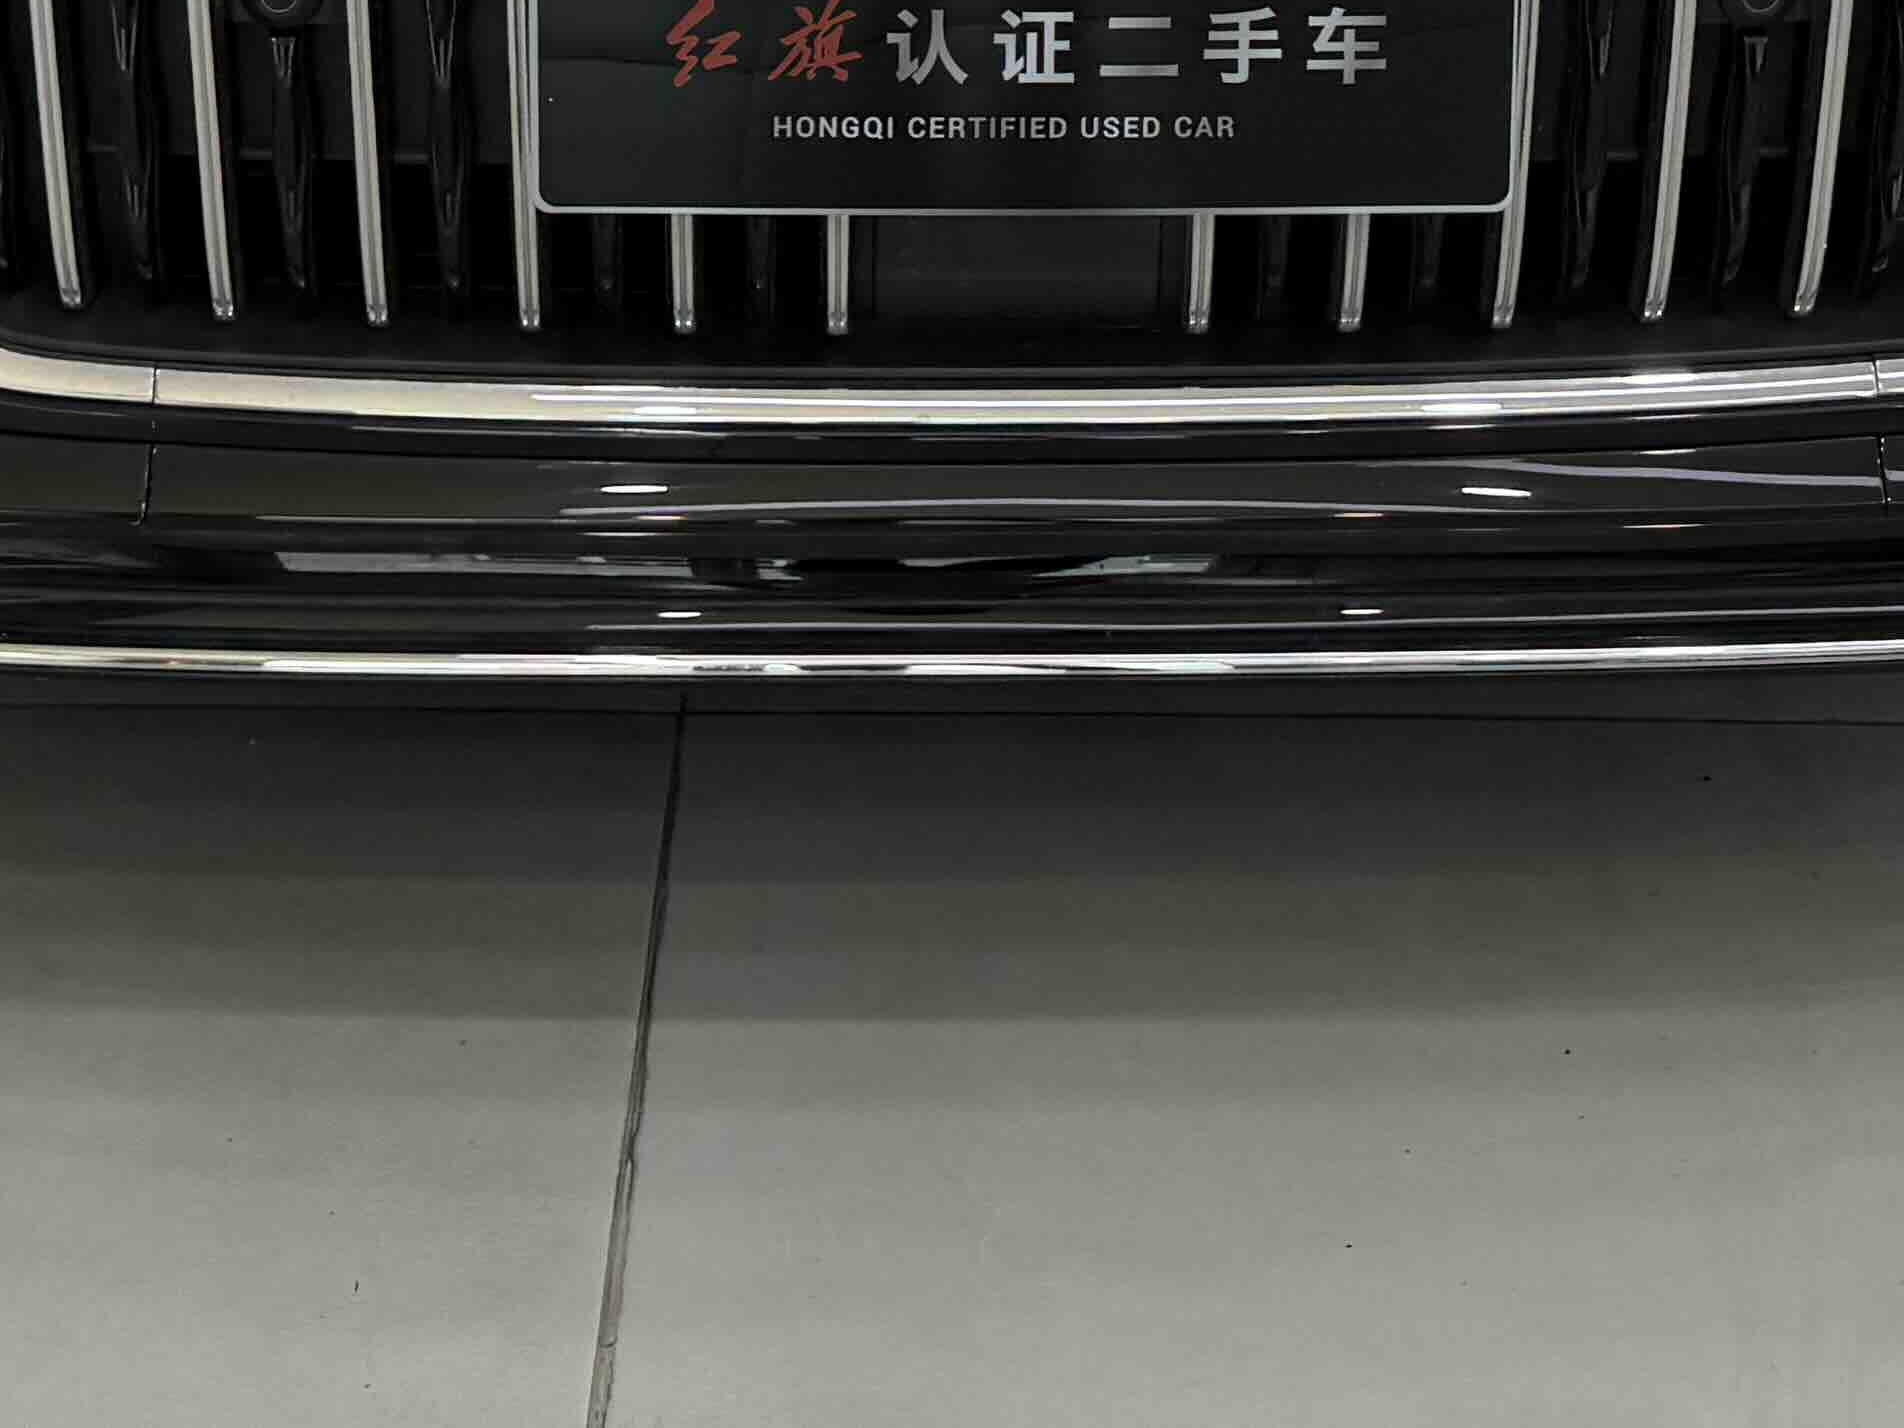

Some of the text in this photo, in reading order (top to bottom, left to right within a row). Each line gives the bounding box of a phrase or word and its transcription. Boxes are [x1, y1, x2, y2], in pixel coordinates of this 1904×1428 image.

[772, 115, 1236, 141] HONGQI CERTIFIED USED CAR
